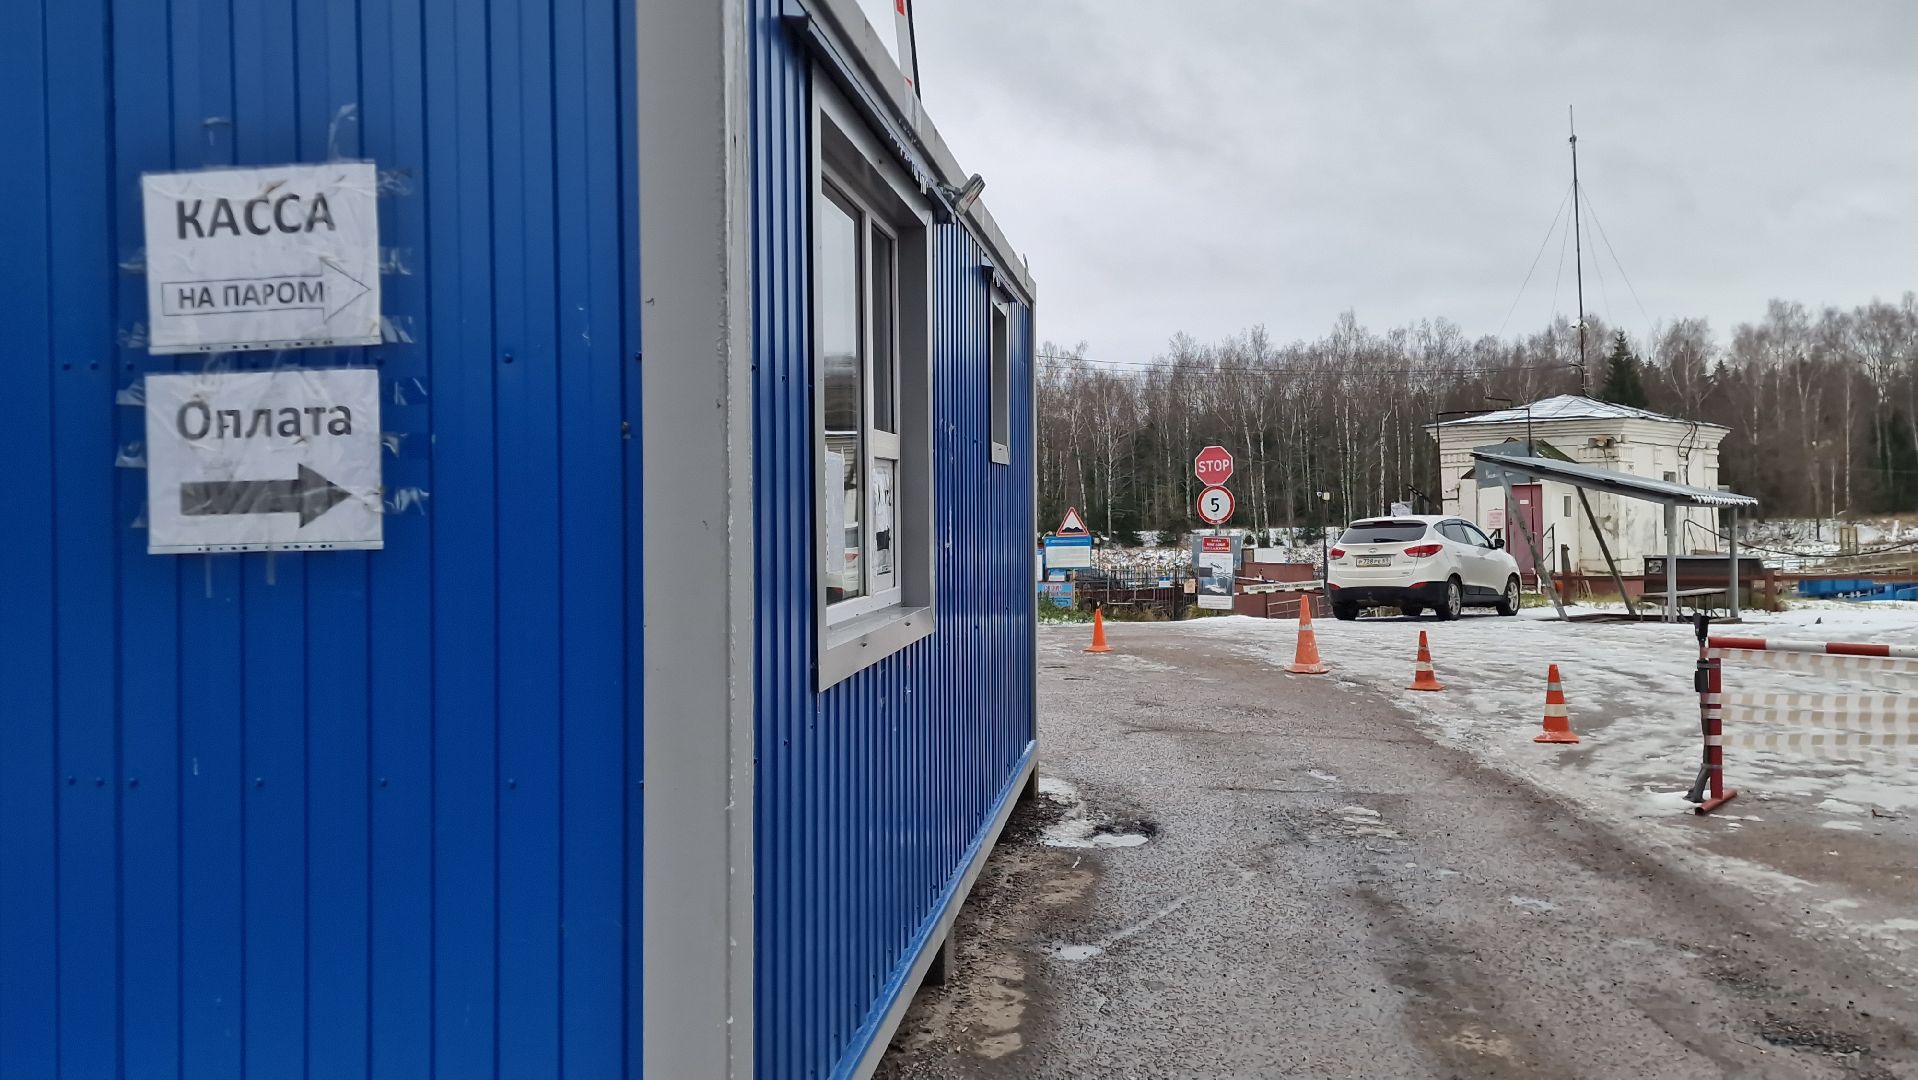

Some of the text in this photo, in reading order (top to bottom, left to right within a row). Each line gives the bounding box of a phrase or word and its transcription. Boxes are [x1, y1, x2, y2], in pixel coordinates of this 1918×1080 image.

[176, 192, 336, 240] КАССА
[179, 281, 325, 309] НА ПАРОМ
[176, 400, 352, 439] Оплата
[1198, 459, 1230, 473] STOP
[1210, 497, 1220, 513] 5
